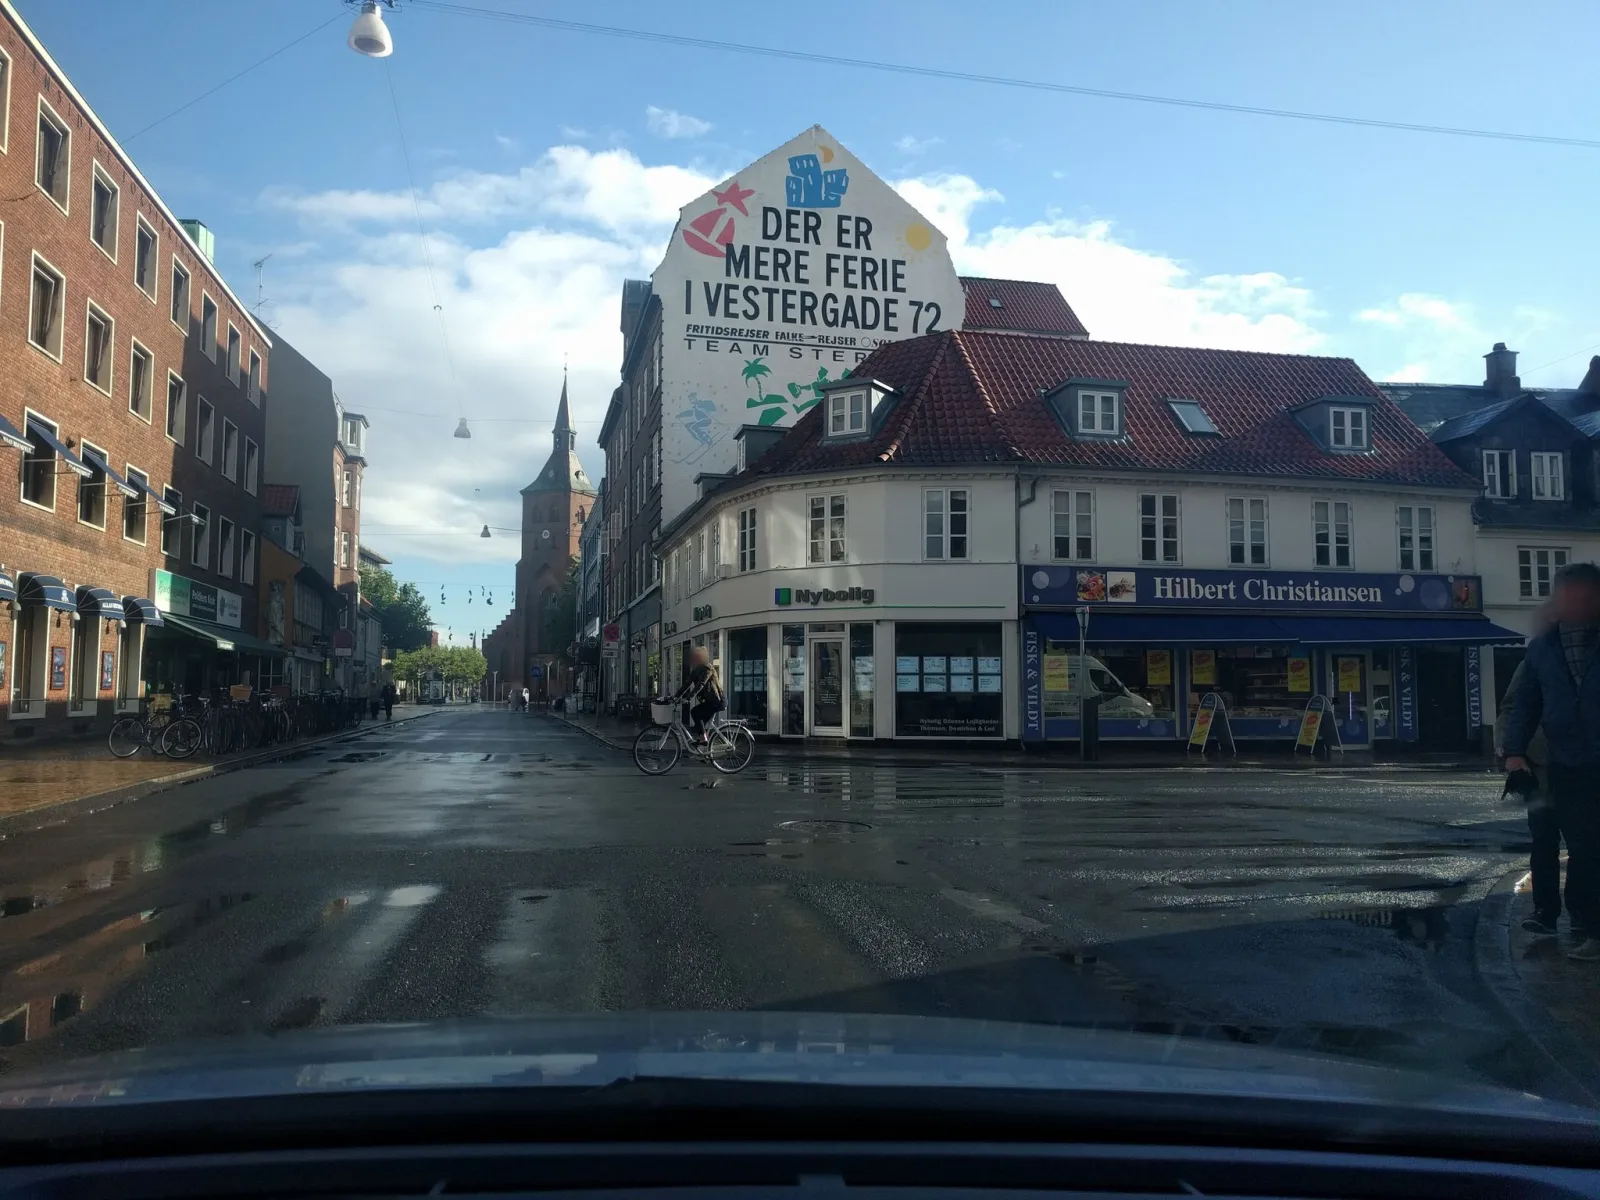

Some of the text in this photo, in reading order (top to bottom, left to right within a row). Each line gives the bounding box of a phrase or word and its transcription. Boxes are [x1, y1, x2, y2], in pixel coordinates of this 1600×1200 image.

[762, 206, 873, 250] DER ER
[725, 243, 906, 293] MERE FERIE
[685, 280, 942, 335] I VESTERGADE 72
[684, 338, 867, 363] TEAM STER
[686, 324, 769, 340] FRITIDSREJSER
[775, 331, 804, 342] FALKE
[818, 335, 857, 346] REJSER
[795, 587, 875, 605] Nybolig
[1154, 577, 1382, 603] Hilbert Christiansen
[1026, 632, 1038, 730] FISK & VILDT
[1400, 646, 1412, 730] ISK & VILDT
[1468, 646, 1480, 728] ISK & VILDT
